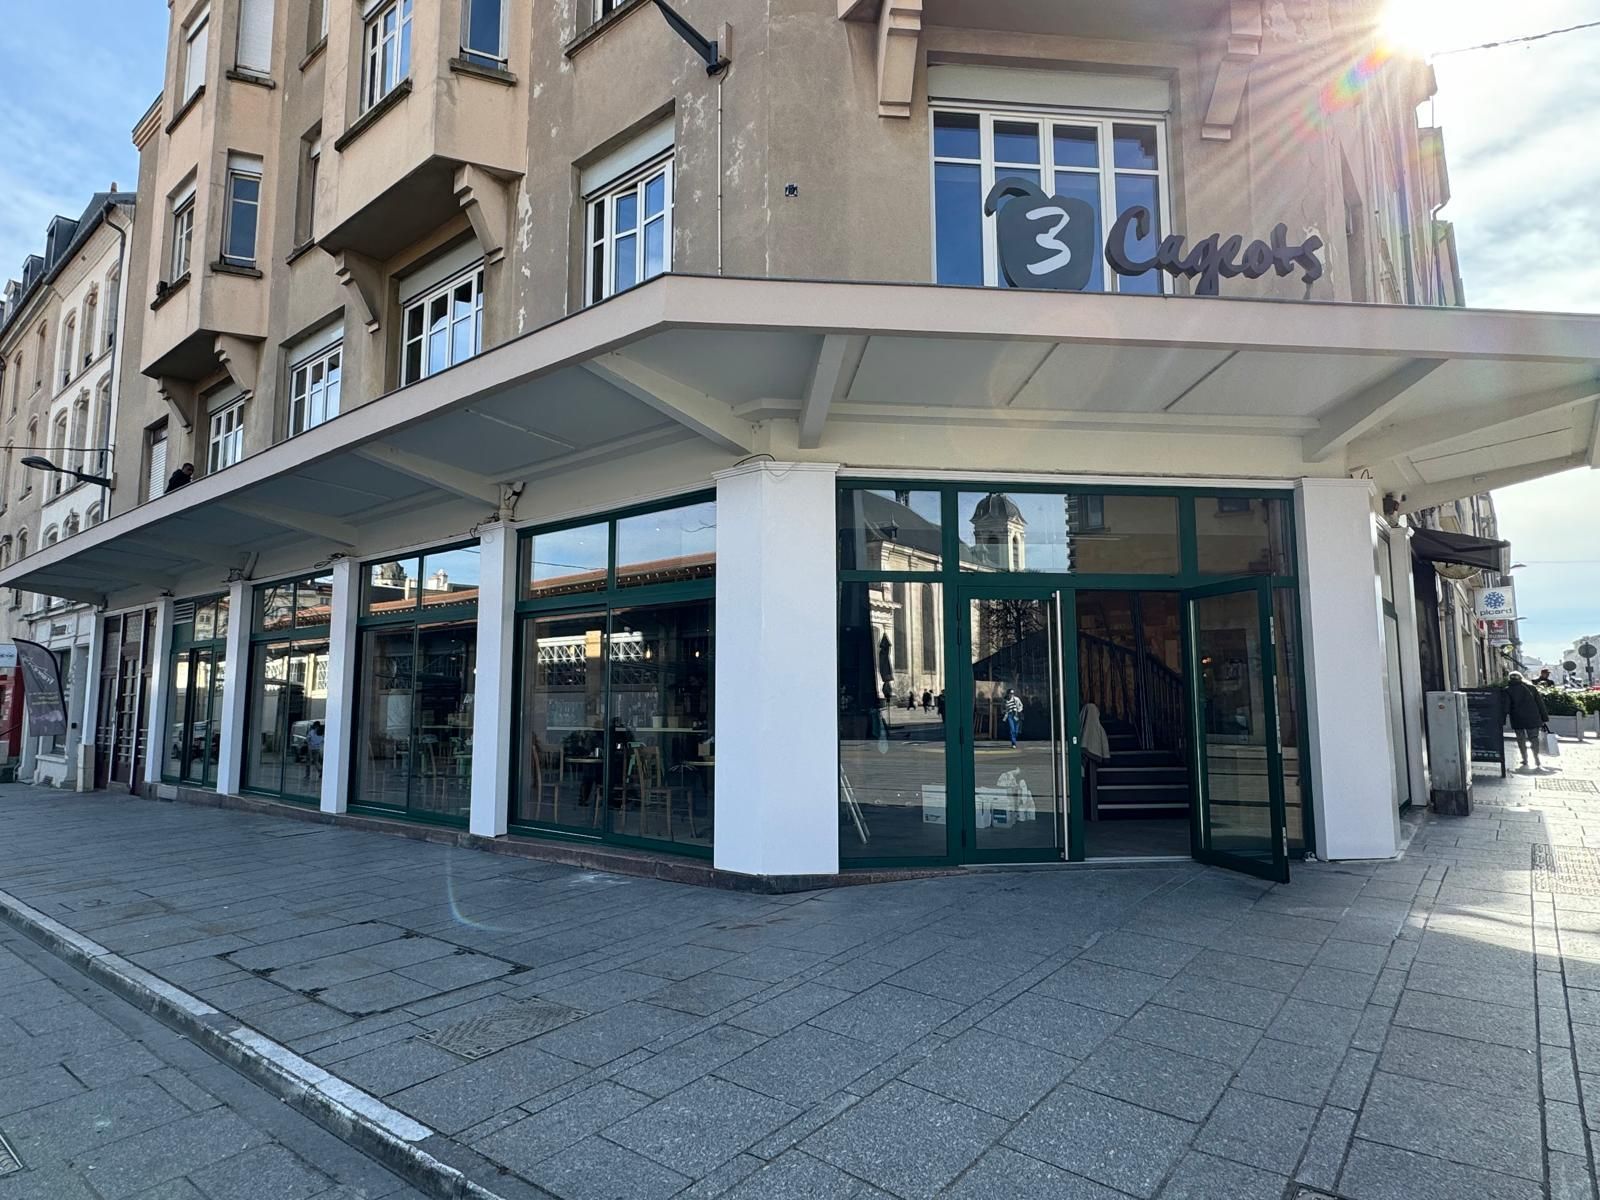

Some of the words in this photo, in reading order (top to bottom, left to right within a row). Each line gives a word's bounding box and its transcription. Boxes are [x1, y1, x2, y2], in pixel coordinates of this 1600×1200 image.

[1026, 206, 1072, 275] 3
[1105, 206, 1323, 297] Cageots
[1480, 608, 1512, 616] picard
